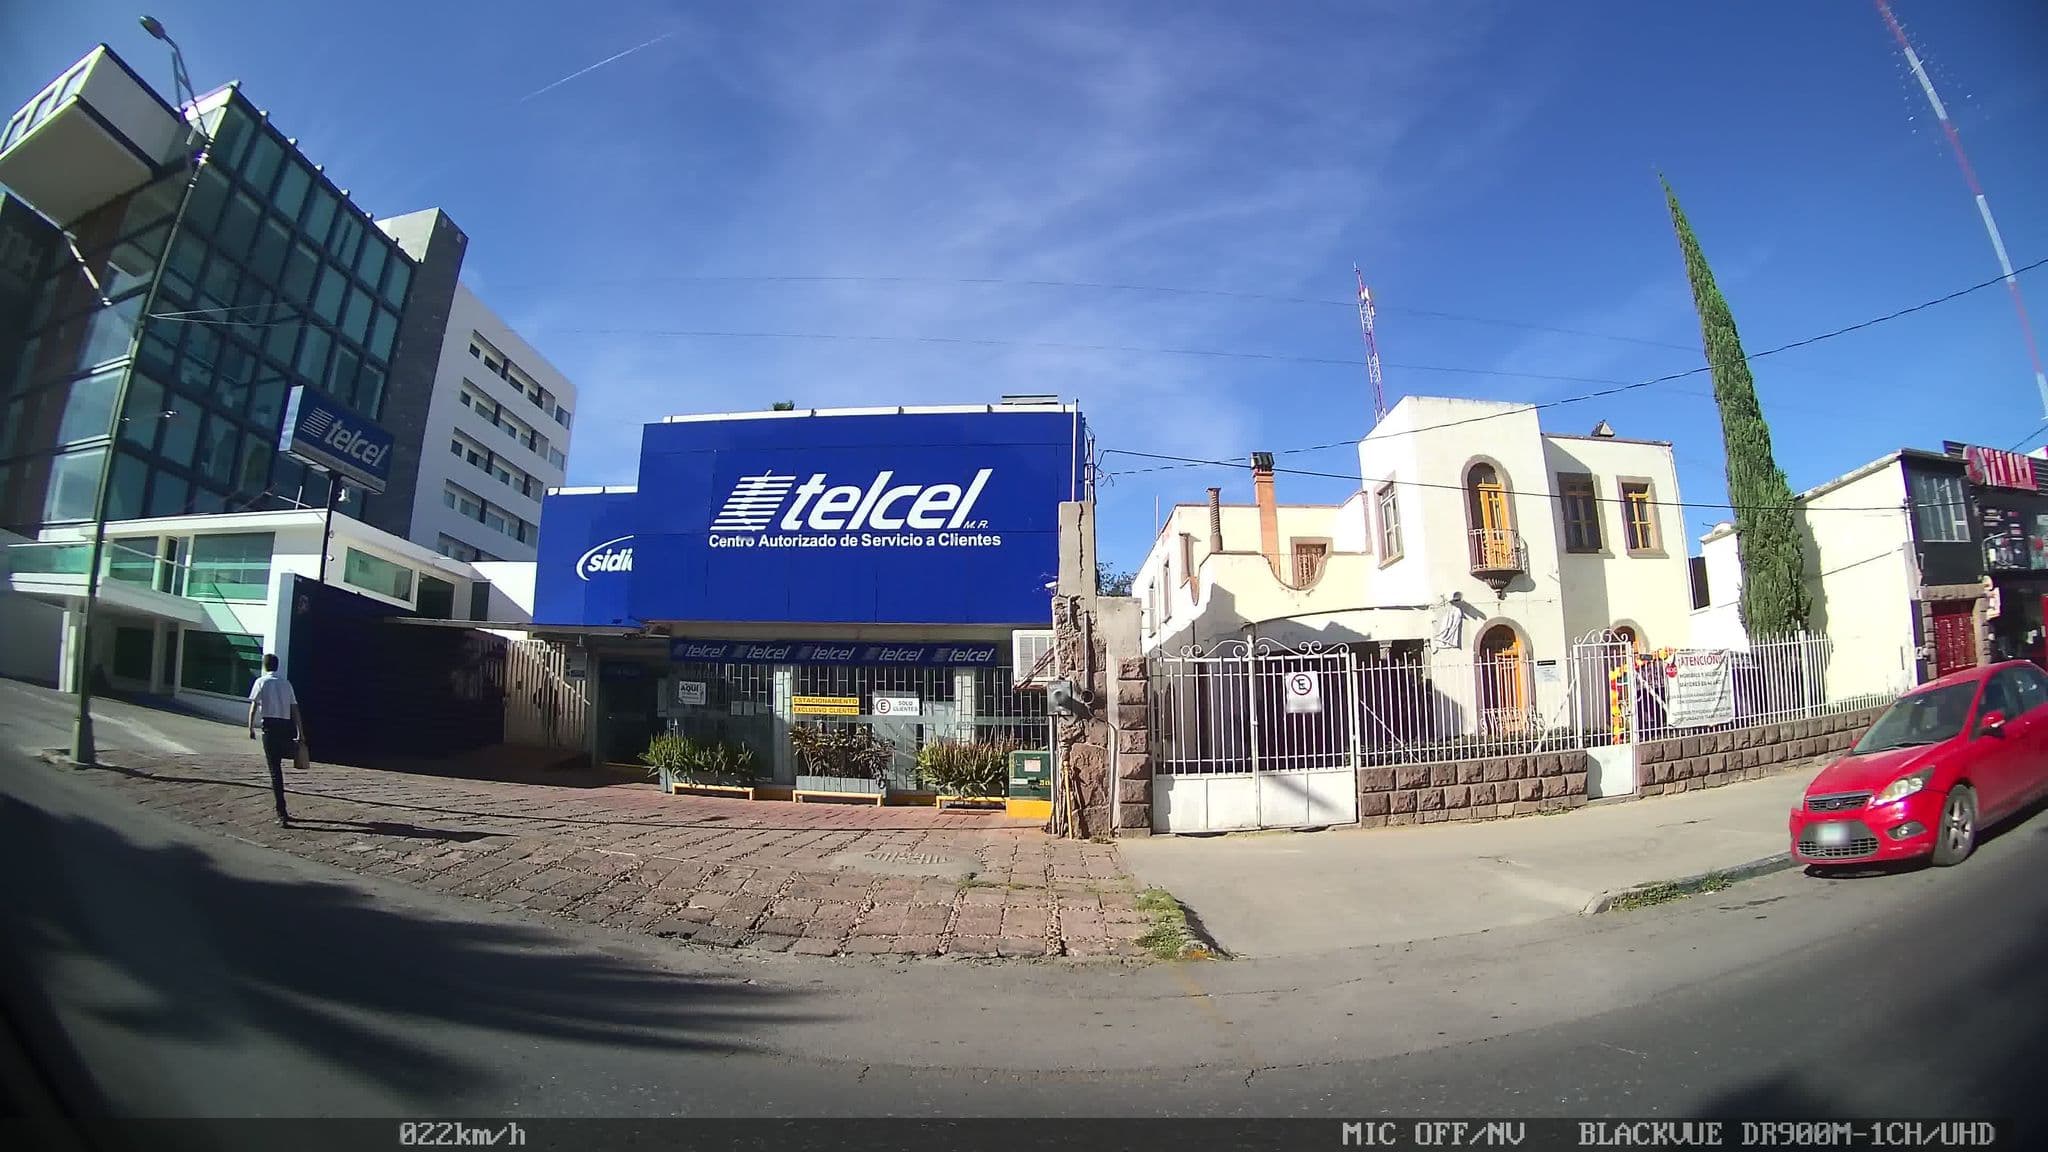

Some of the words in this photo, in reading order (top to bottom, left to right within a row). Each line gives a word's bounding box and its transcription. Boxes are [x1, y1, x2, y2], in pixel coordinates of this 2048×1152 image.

[325, 420, 389, 466] telcel
[780, 468, 993, 530] telcel
[709, 535, 754, 547] Centro
[758, 534, 837, 548] Autorizado
[840, 535, 858, 547] de
[861, 534, 922, 546] Servicio
[926, 536, 935, 546] a
[938, 532, 1001, 546] Clientes
[685, 644, 727, 658] telcel
[746, 645, 791, 660] telcel
[811, 646, 856, 661] telcel
[878, 648, 924, 661] telcel
[948, 648, 995, 662] telcel
